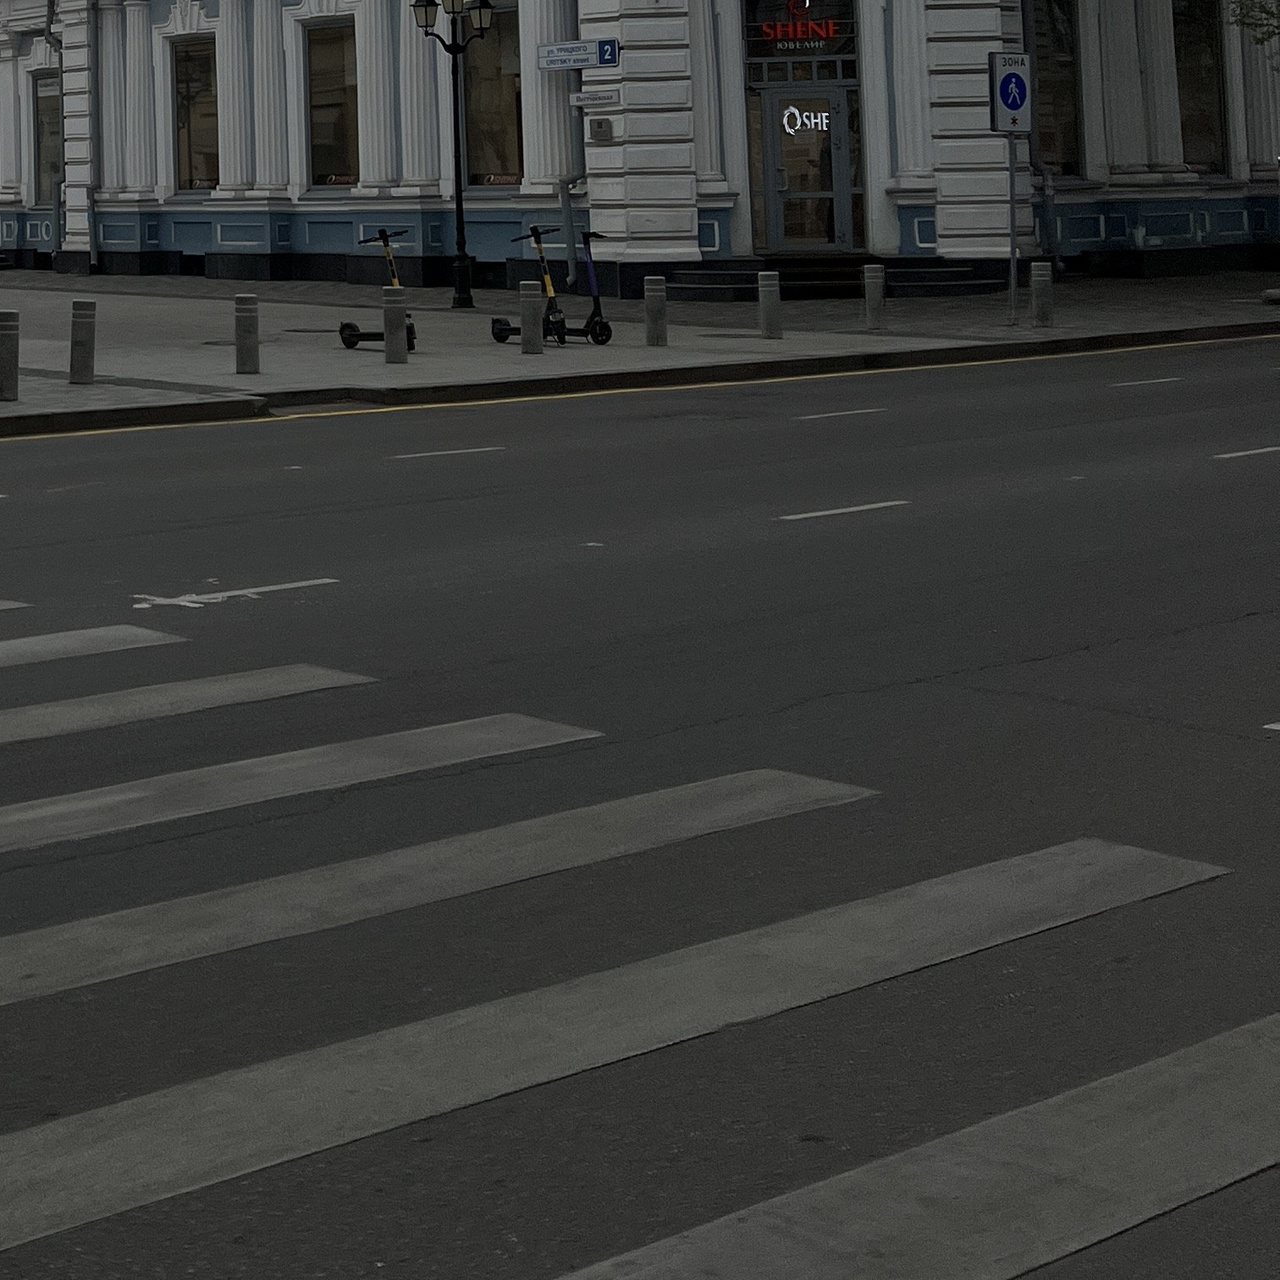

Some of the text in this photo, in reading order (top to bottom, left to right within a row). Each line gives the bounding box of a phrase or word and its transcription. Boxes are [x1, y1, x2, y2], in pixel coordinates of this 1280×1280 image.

[759, 19, 840, 41] SHENE
[776, 40, 826, 50] ЮВЕЛИР
[603, 45, 612, 60] 2
[1001, 57, 1026, 67] ЗОНА
